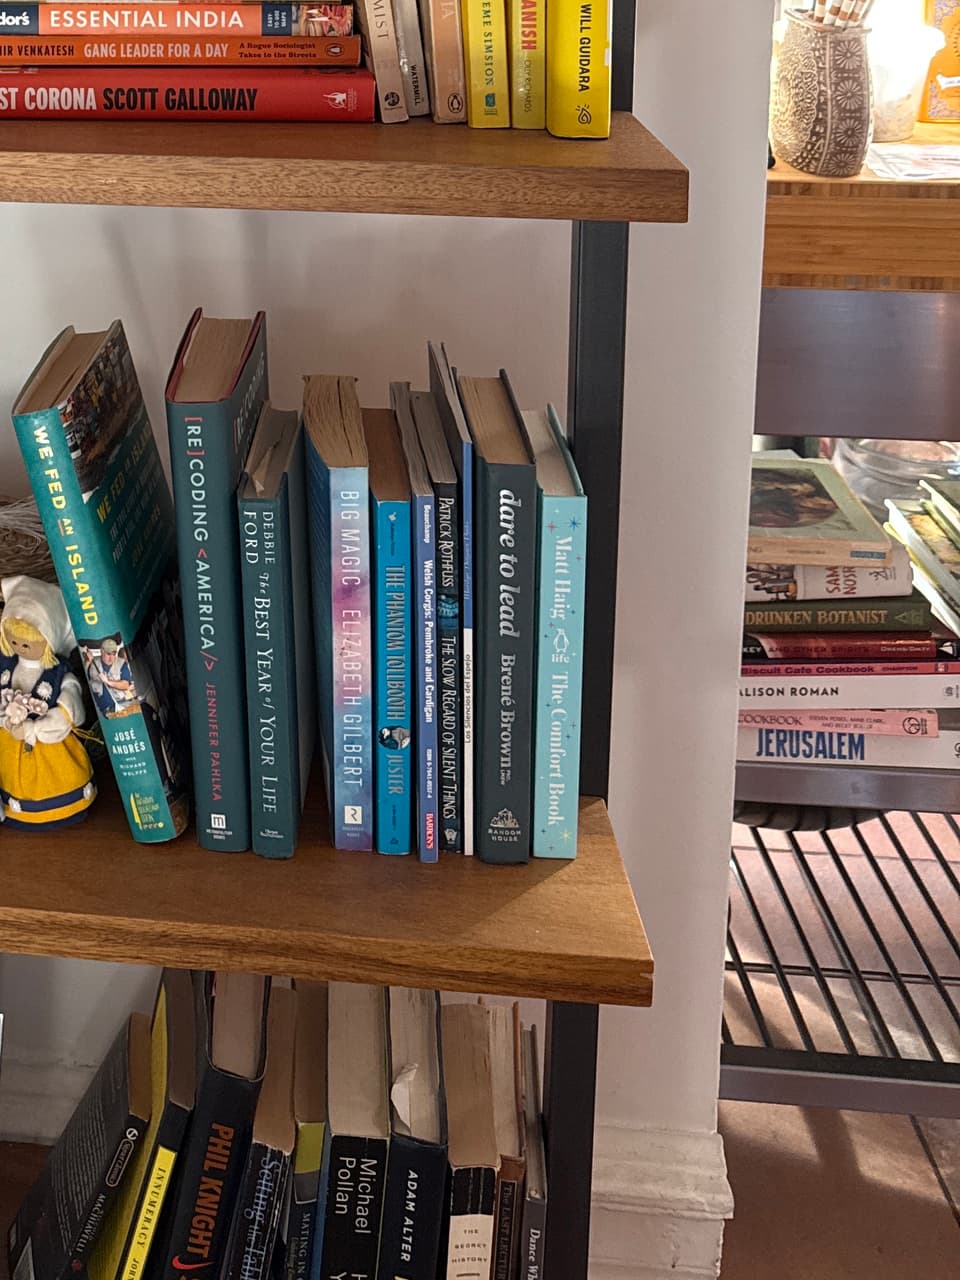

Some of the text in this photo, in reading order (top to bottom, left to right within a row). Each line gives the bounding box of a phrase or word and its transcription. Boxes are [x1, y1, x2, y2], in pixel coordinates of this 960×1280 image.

[49, 11, 169, 28] ESSENTIAL
[175, 10, 244, 27] INDIA
[580, 4, 592, 32] WILL
[17, 45, 75, 57] VENKATESH
[84, 44, 116, 58] GANG
[120, 44, 163, 58] LEADER
[167, 44, 190, 58] FOR
[193, 44, 201, 57] A
[205, 44, 228, 57] DAY
[577, 36, 592, 92] GUIDARA
[24, 88, 97, 110] CORONA
[103, 88, 158, 110] SCOTT
[165, 88, 258, 111] GALLOWAY
[339, 491, 363, 788] BIG MAGIC ELIZABETH GILBERT
[500, 487, 522, 770] dare to lead Brené Brown
[746, 611, 888, 624] DRUNKEN BOTANIST
[790, 687, 839, 696] ROMAN
[756, 729, 864, 760] JERUSALEM
[137, 1167, 167, 1248] INNUMERACY
[186, 1122, 234, 1257] PHIL KNIGHT
[335, 1157, 356, 1214] Pollan
[354, 1159, 377, 1234] Michael
[401, 1170, 418, 1262] ADAM ALTER
